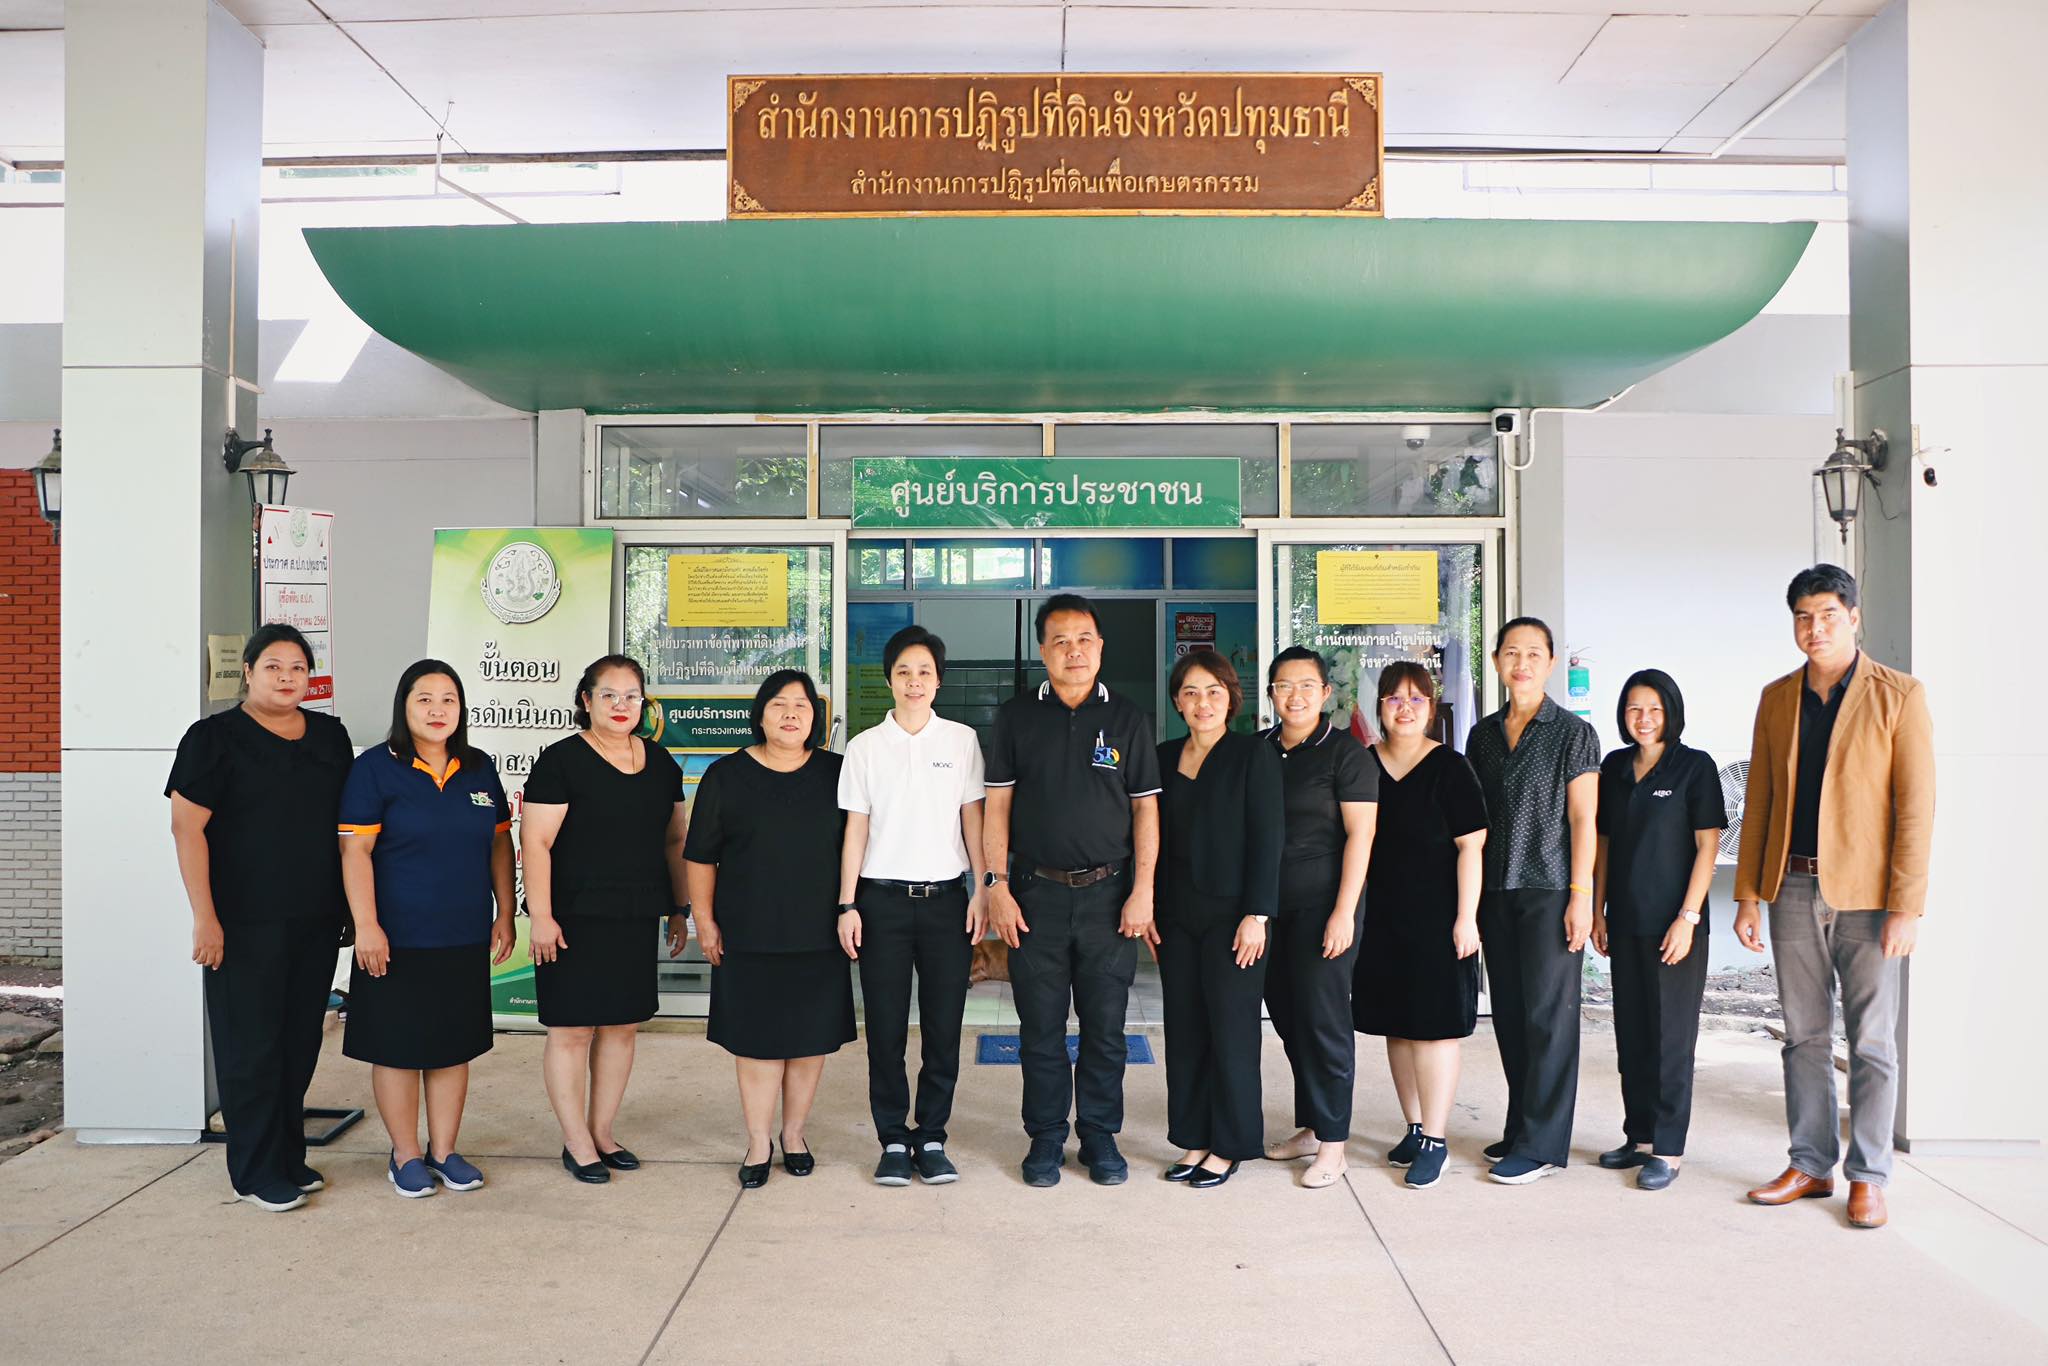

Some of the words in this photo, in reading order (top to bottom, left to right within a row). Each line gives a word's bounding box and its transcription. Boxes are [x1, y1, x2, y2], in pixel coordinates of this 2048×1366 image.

[758, 78, 1350, 154] สำนักงานการปฏิรูปที่ดินจังหวัดปทุมธานี
[850, 157, 1260, 203] สำนักงานการปฏิรูปที่ดินเพื่อเกษตรกรรม
[890, 469, 1203, 518] ศูนย์บริการประชาชน
[479, 640, 557, 679] ขั้นตอน
